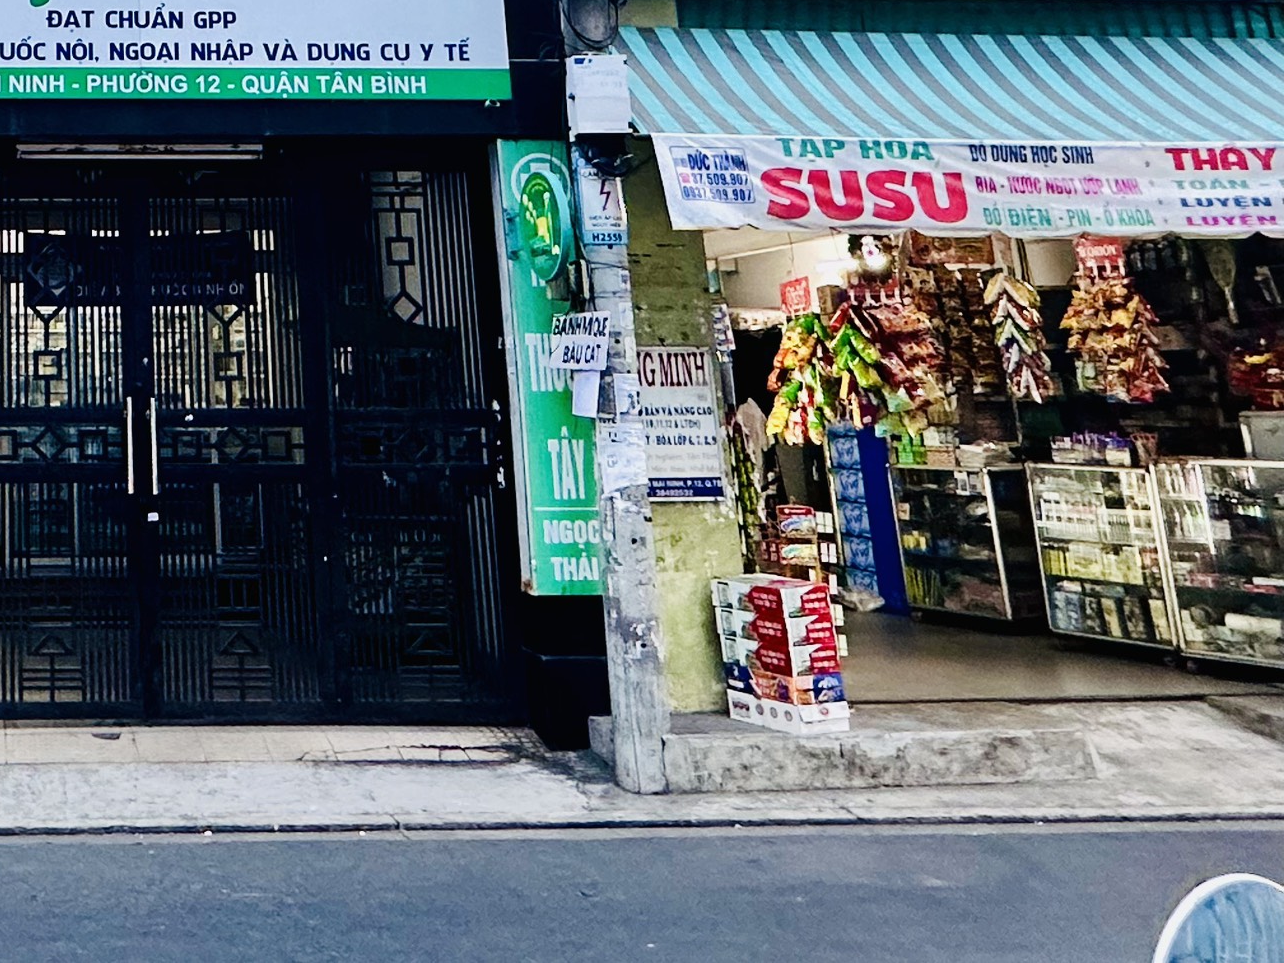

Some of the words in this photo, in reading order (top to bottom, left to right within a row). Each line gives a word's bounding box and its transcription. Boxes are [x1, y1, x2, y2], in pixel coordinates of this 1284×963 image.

[46, 9, 94, 33] ĐẠT
[105, 3, 183, 29] CHUẨN
[193, 10, 237, 29] GPP
[56, 38, 99, 64] NỘI,
[191, 39, 253, 65] NHẬP
[263, 38, 298, 61] VÀ
[307, 42, 370, 65] DỤNG
[380, 42, 410, 65] CỤ
[420, 43, 434, 61] Y
[445, 37, 470, 61] TẾ
[8, 74, 65, 93] NINH
[86, 71, 188, 94] PHƯỜNG
[195, 75, 220, 93] 12
[241, 71, 308, 98] QUẬN
[316, 72, 364, 94] TÂN
[371, 71, 426, 94] BÌNH
[775, 138, 845, 162] TẠP
[1062, 146, 1094, 164] SINH
[759, 167, 968, 223] SUSU
[975, 176, 997, 194] BIA
[658, 352, 708, 387] MINH
[547, 426, 586, 500] TÂY
[543, 520, 600, 549] NGỌC
[550, 552, 600, 581] THÁI
